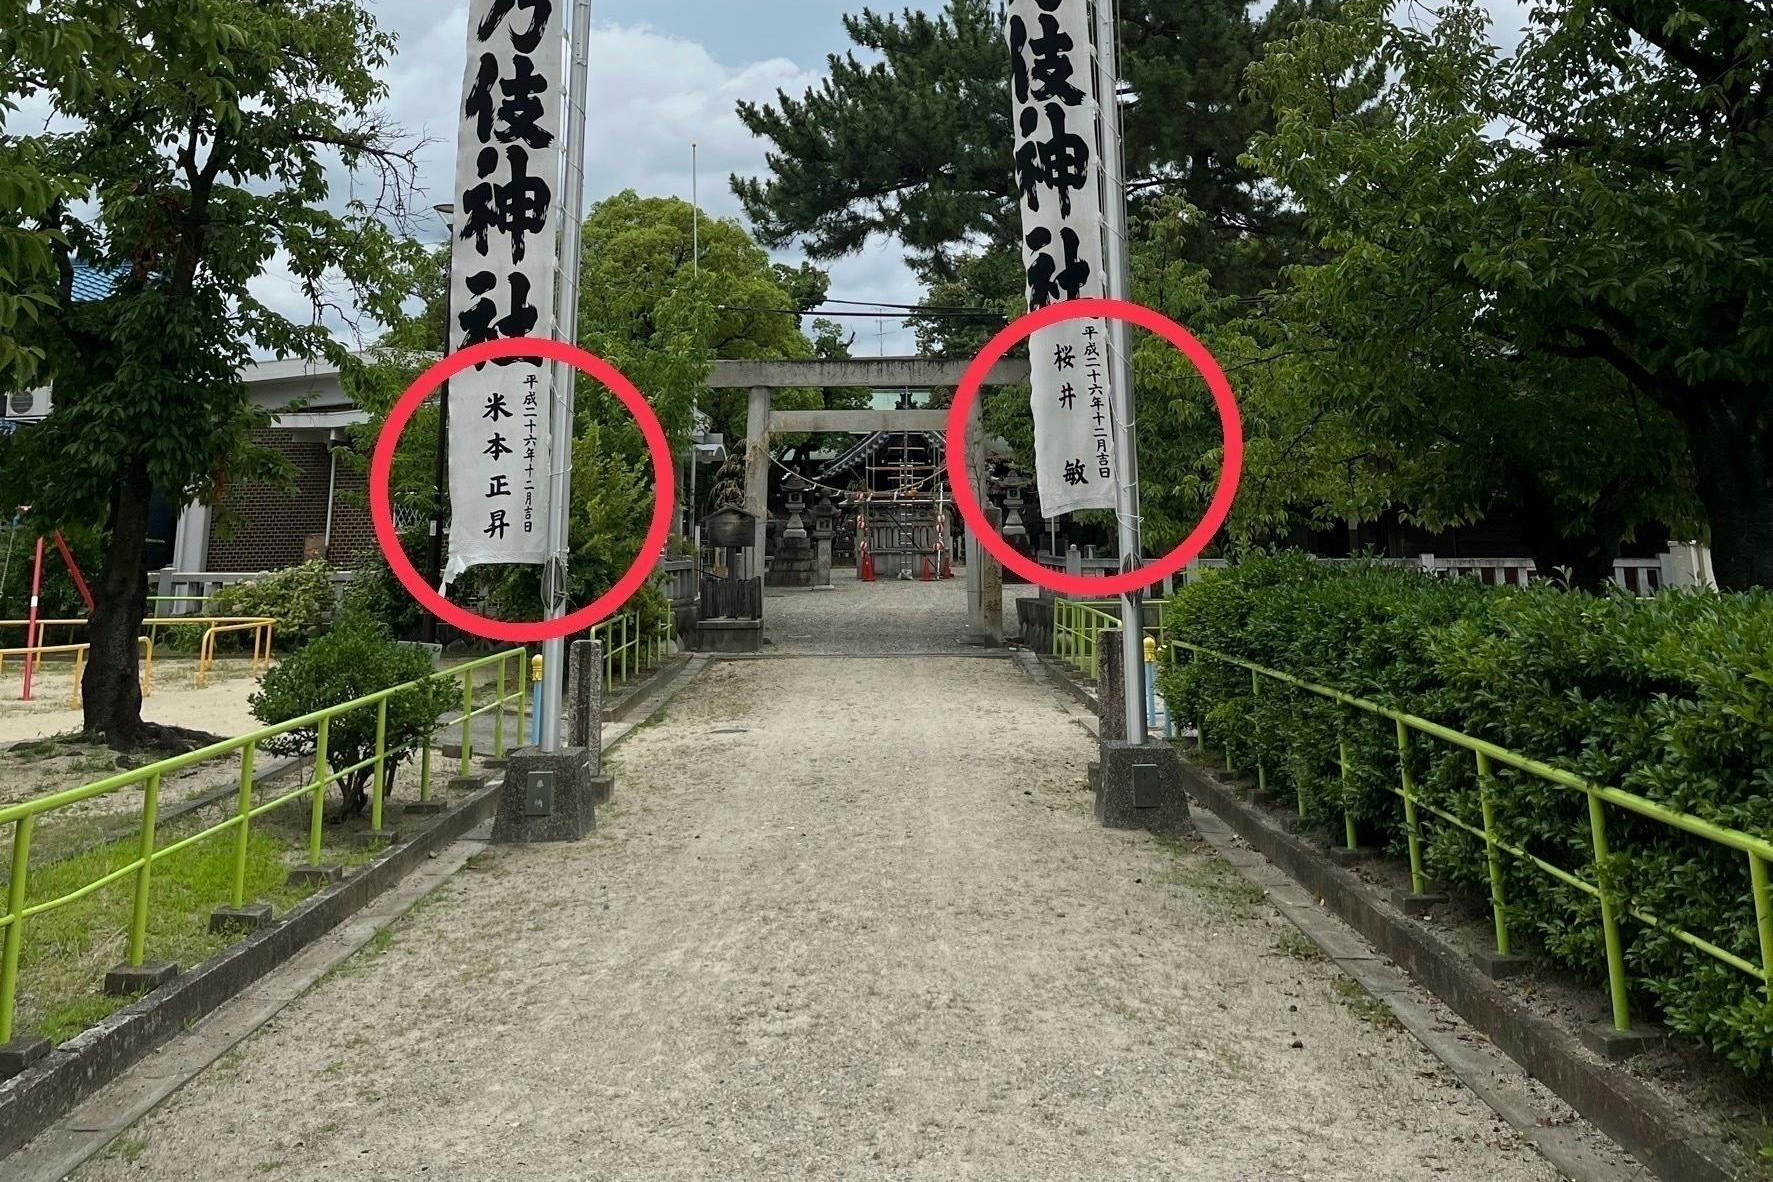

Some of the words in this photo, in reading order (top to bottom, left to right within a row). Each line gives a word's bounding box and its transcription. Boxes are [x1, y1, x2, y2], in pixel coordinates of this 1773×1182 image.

[482, 392, 514, 540] 米本正昇
[522, 374, 539, 533] 平成二十六年十二月吉日
[1082, 325, 1111, 479] 平成二十六年十二月吉日
